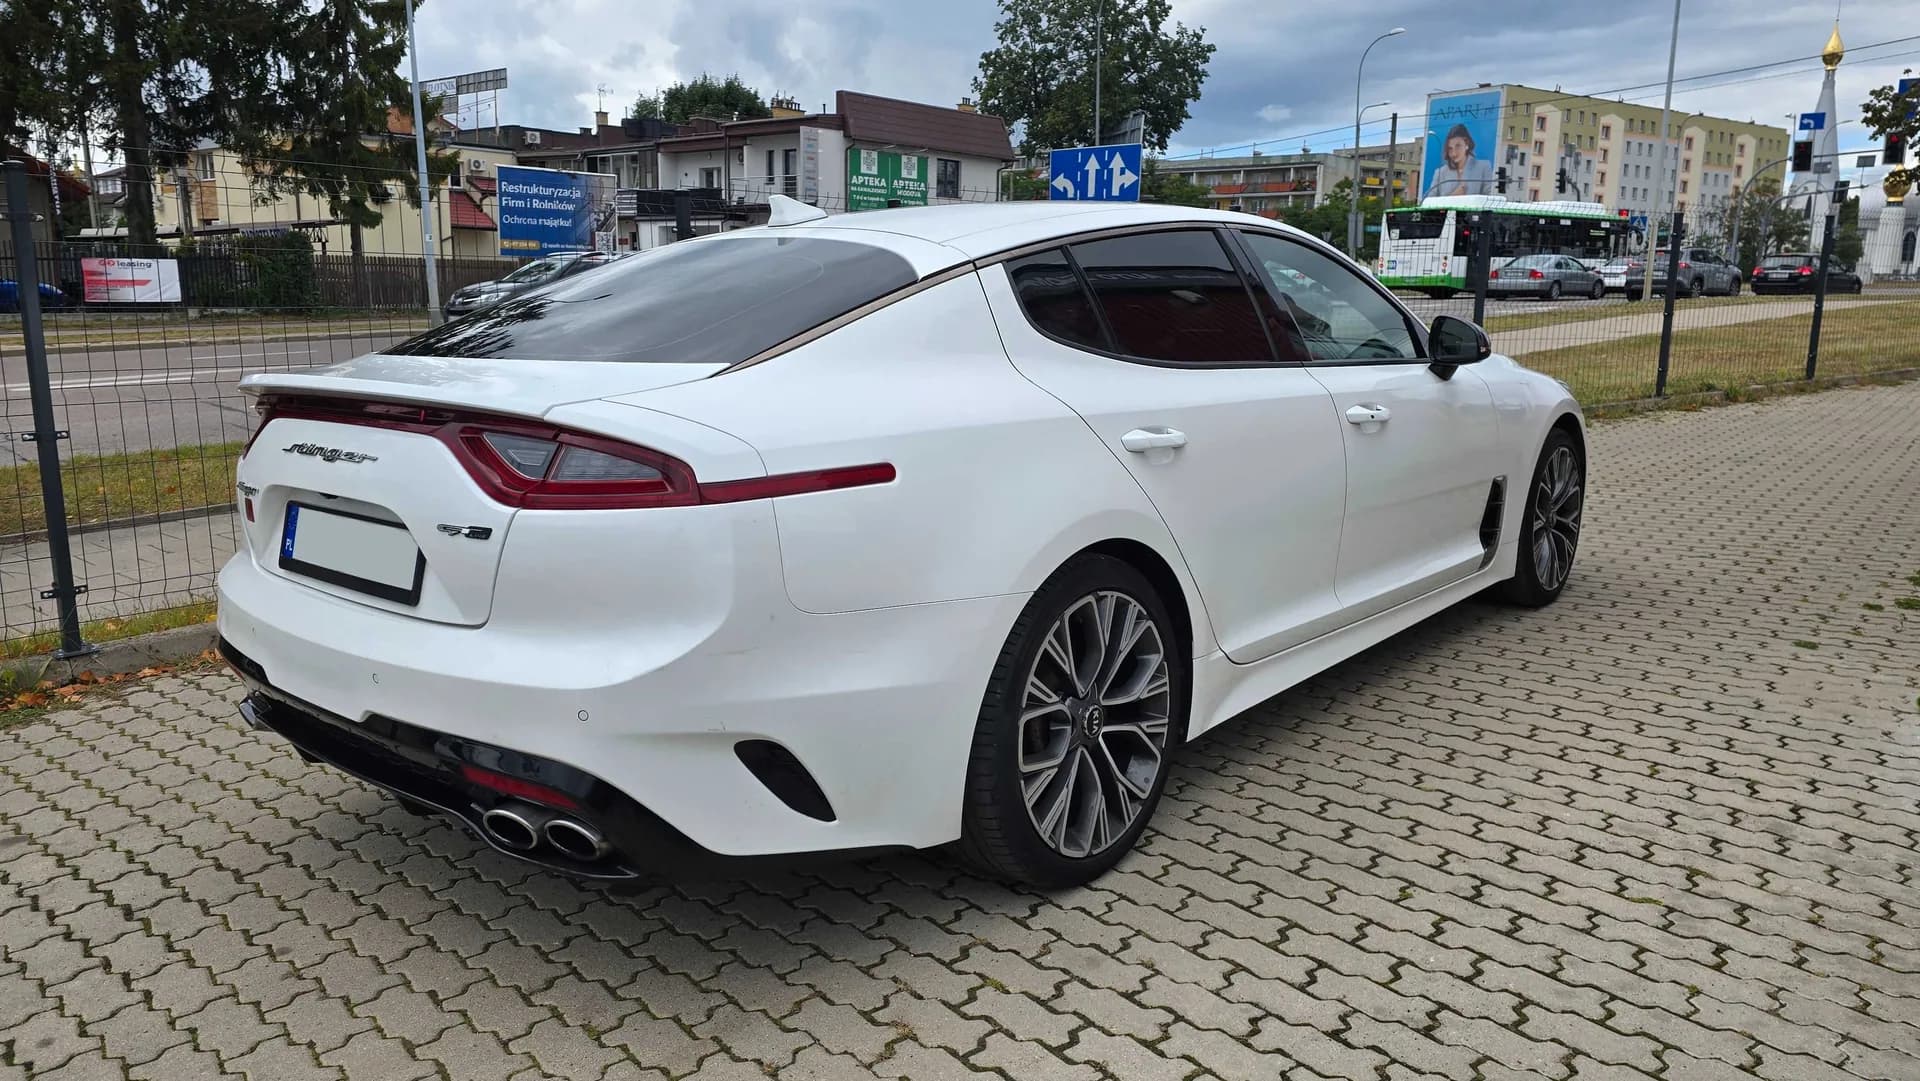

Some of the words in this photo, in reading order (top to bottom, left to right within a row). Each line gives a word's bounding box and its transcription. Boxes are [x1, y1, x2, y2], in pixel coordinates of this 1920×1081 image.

[851, 175, 887, 187] APTEKA
[892, 180, 926, 191] APTEKA
[501, 181, 581, 199] Restrukturyzacja
[502, 197, 525, 208] Firm
[527, 199, 530, 208] i
[533, 199, 576, 211] Rolników
[503, 215, 538, 225] Ochrona
[539, 218, 572, 228] majątku!
[117, 260, 152, 268] leasing
